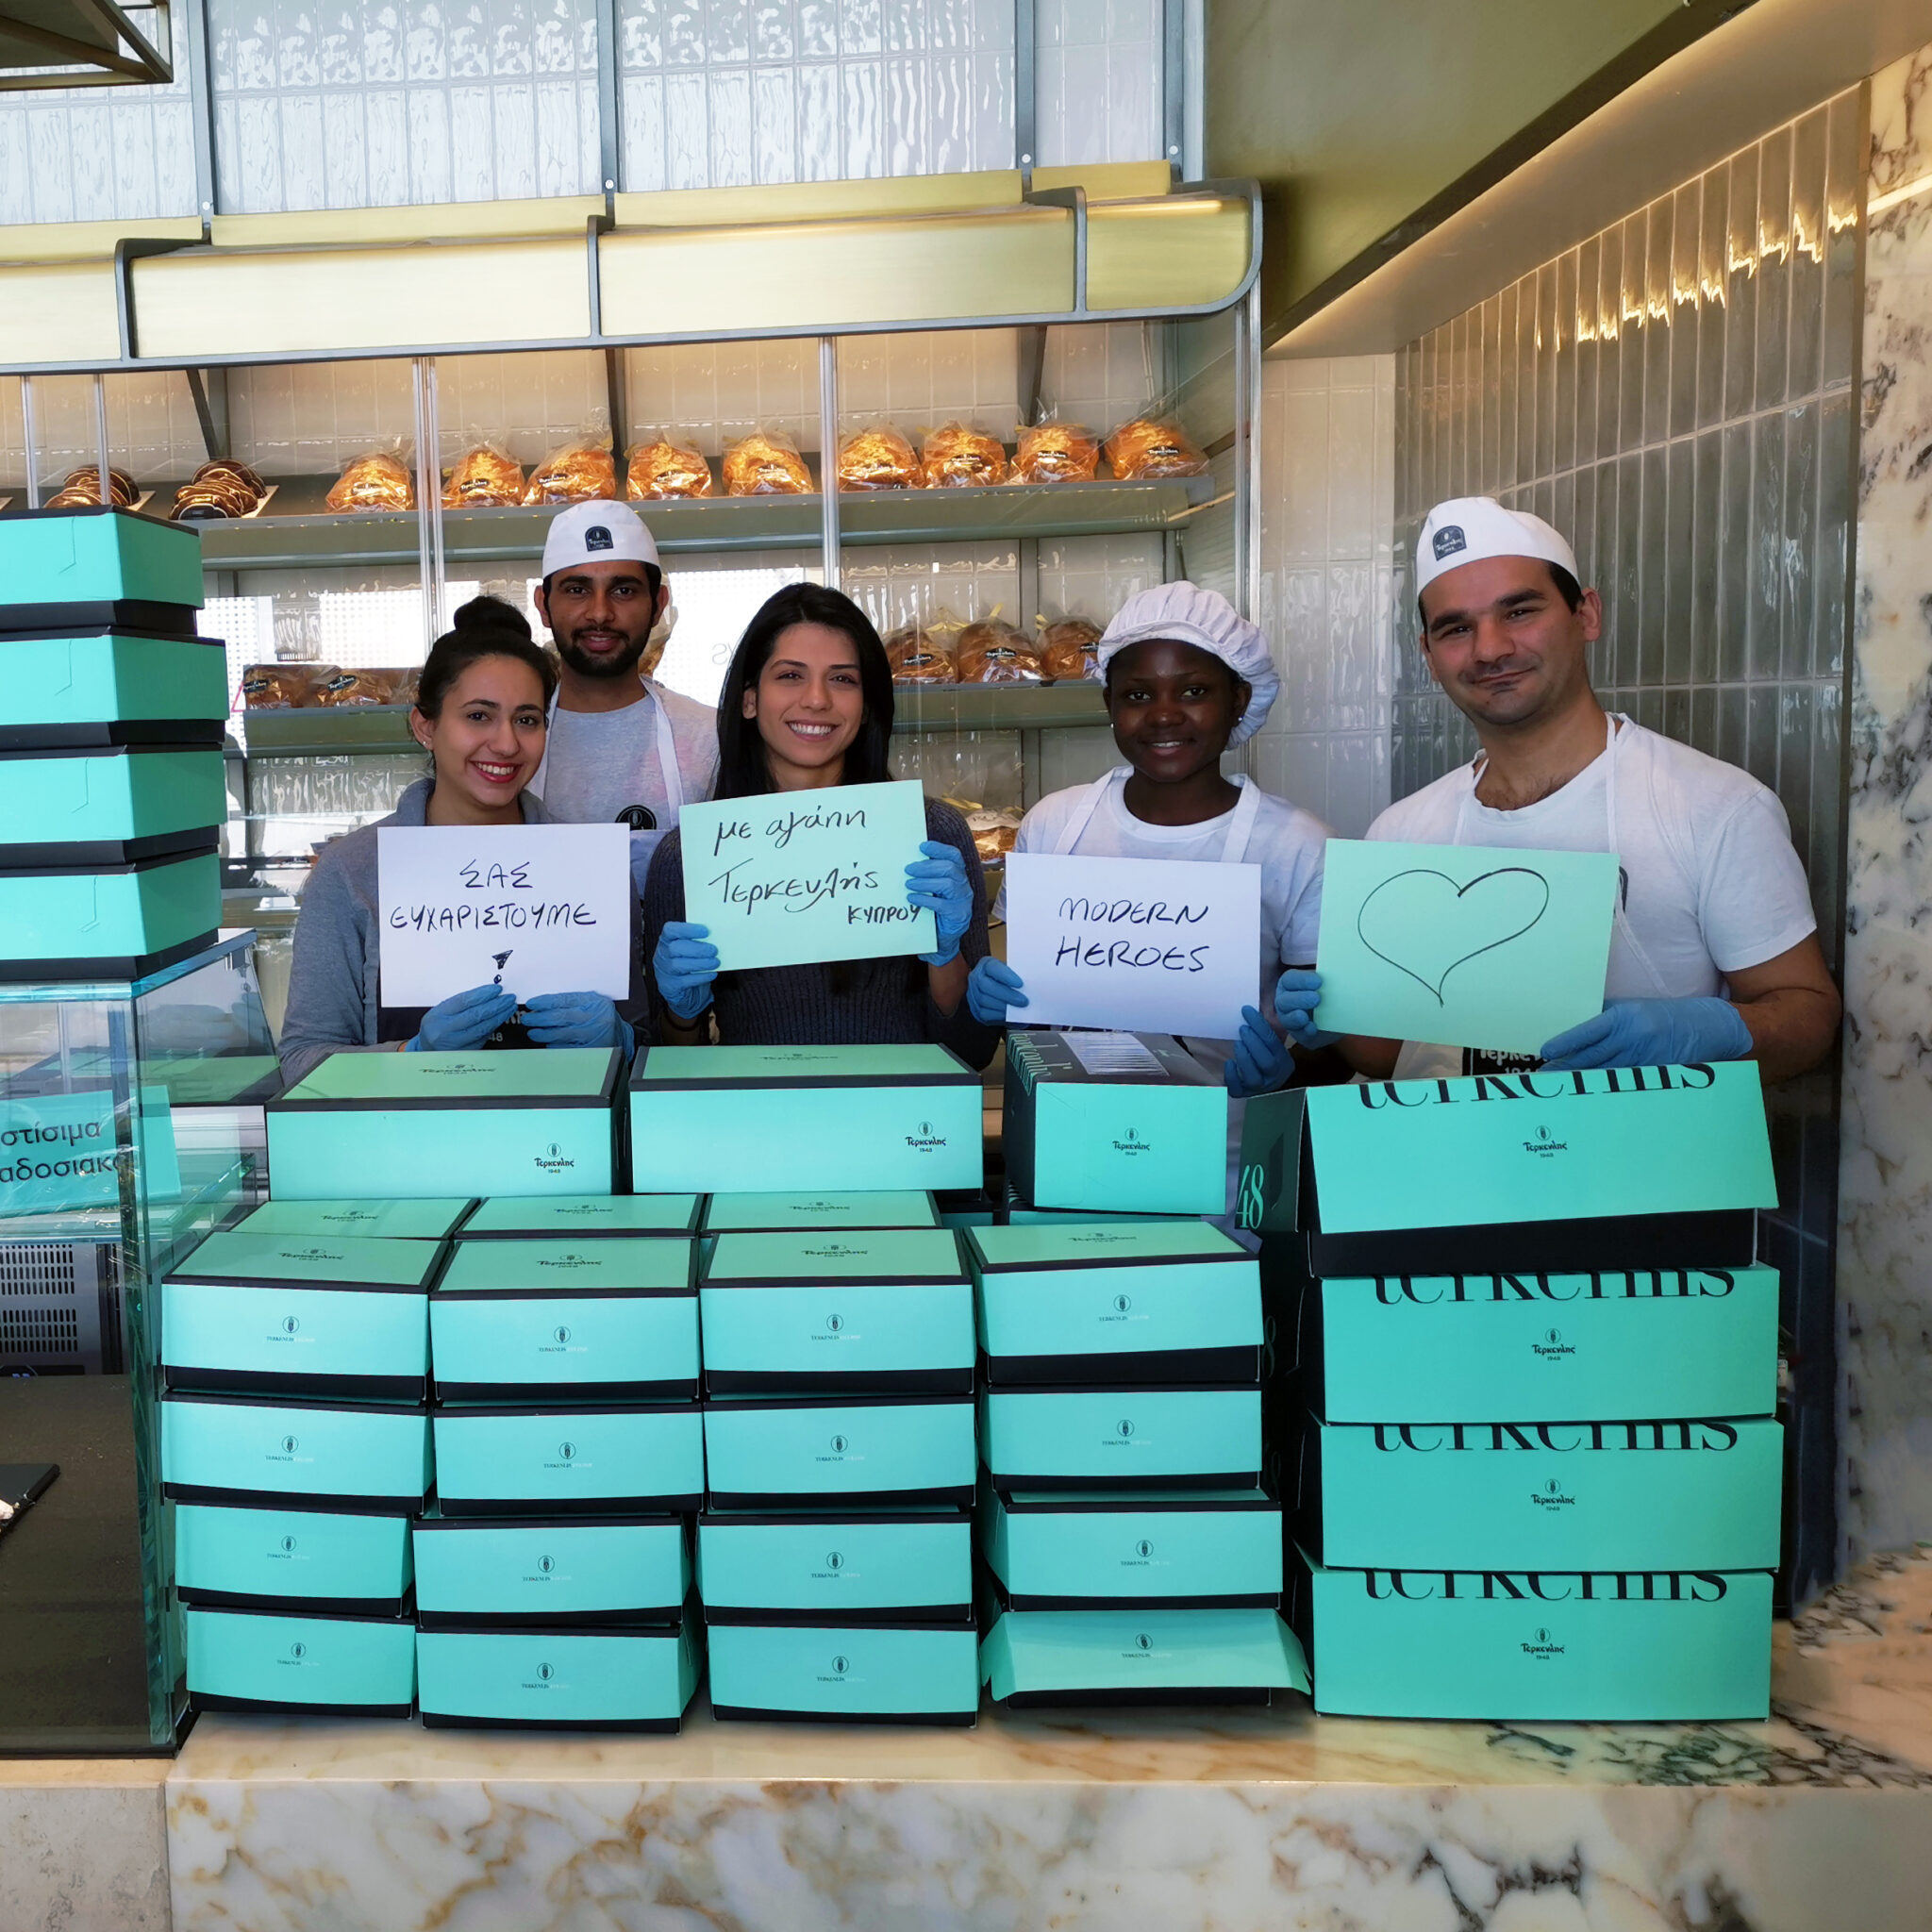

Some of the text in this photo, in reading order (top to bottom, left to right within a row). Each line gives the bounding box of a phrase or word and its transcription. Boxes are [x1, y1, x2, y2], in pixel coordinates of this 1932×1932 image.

[714, 821, 752, 857] με
[458, 858, 534, 889] ΣΑΣ
[390, 901, 597, 930] ΕΥΧΑΡΙΣΤΟΥΜΕ
[847, 903, 922, 925] ΚΥΠΡΟΥ
[1058, 896, 1209, 926] MODERN
[1055, 934, 1210, 974] HEROES
